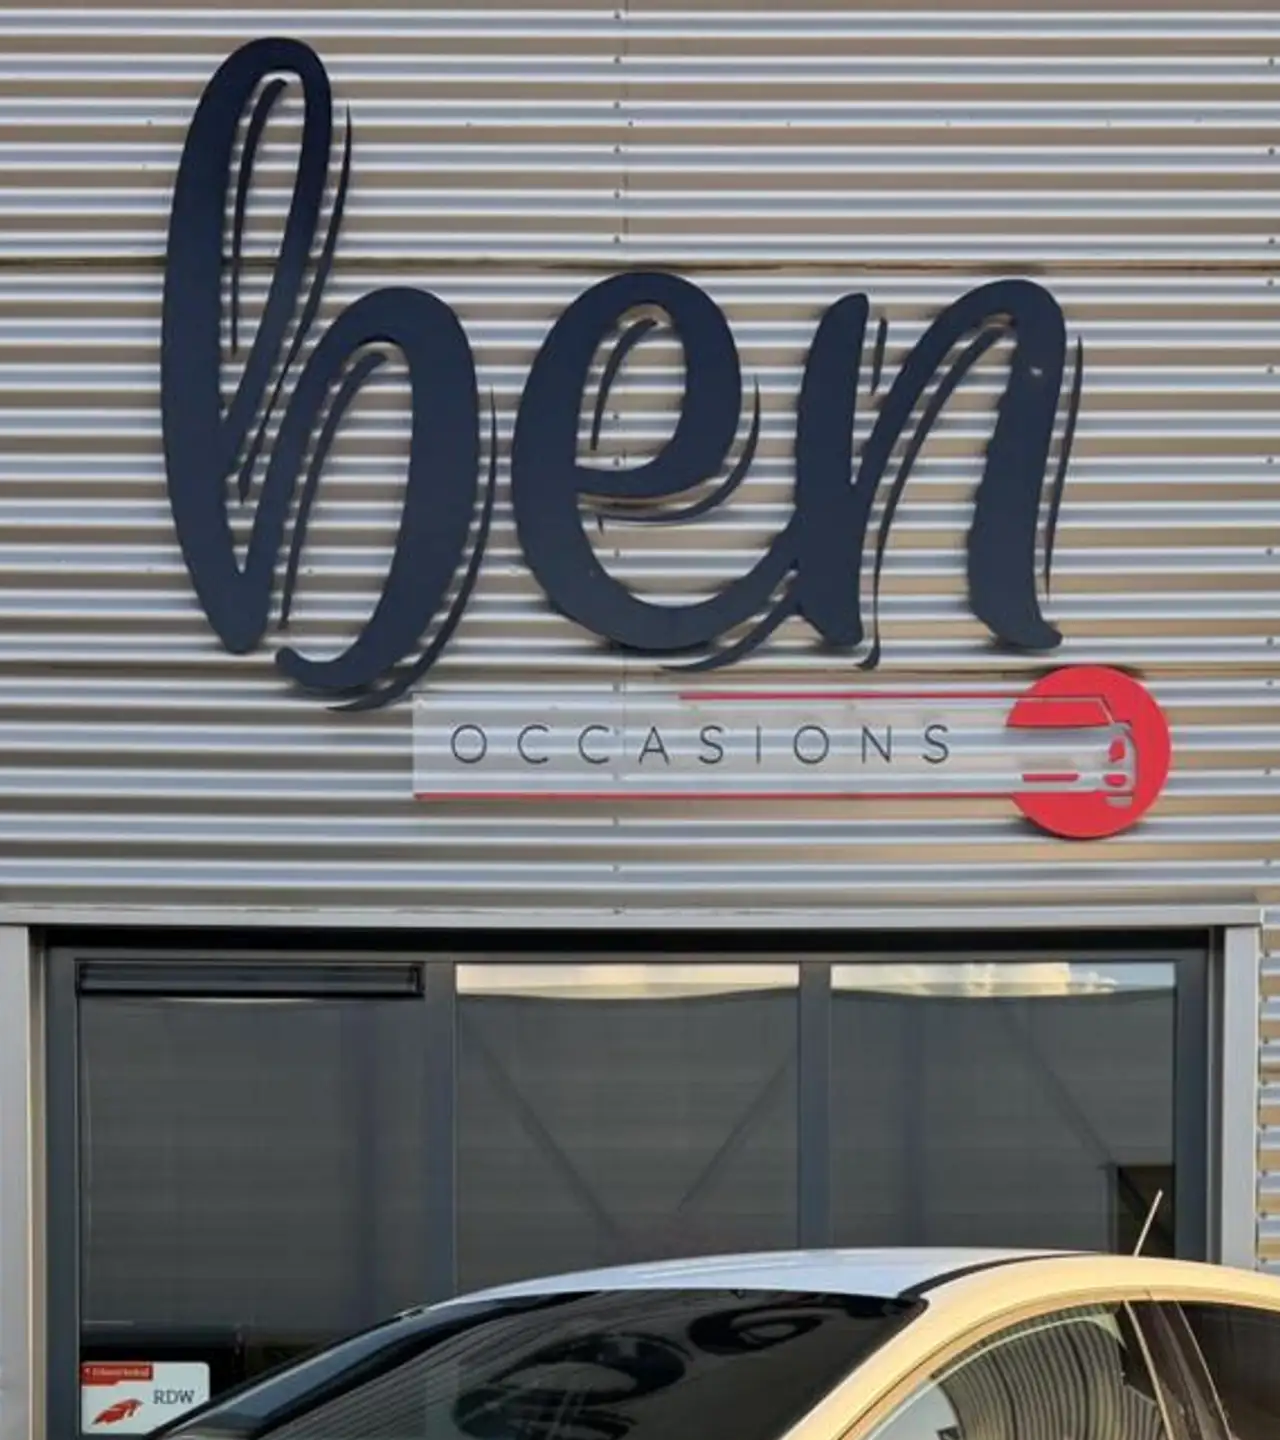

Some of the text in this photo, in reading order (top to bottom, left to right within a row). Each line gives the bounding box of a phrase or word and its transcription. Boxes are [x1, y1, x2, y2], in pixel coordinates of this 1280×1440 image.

[161, 37, 1081, 708] ben
[450, 724, 951, 765] OCCASIONS
[153, 1390, 195, 1404] RDW
